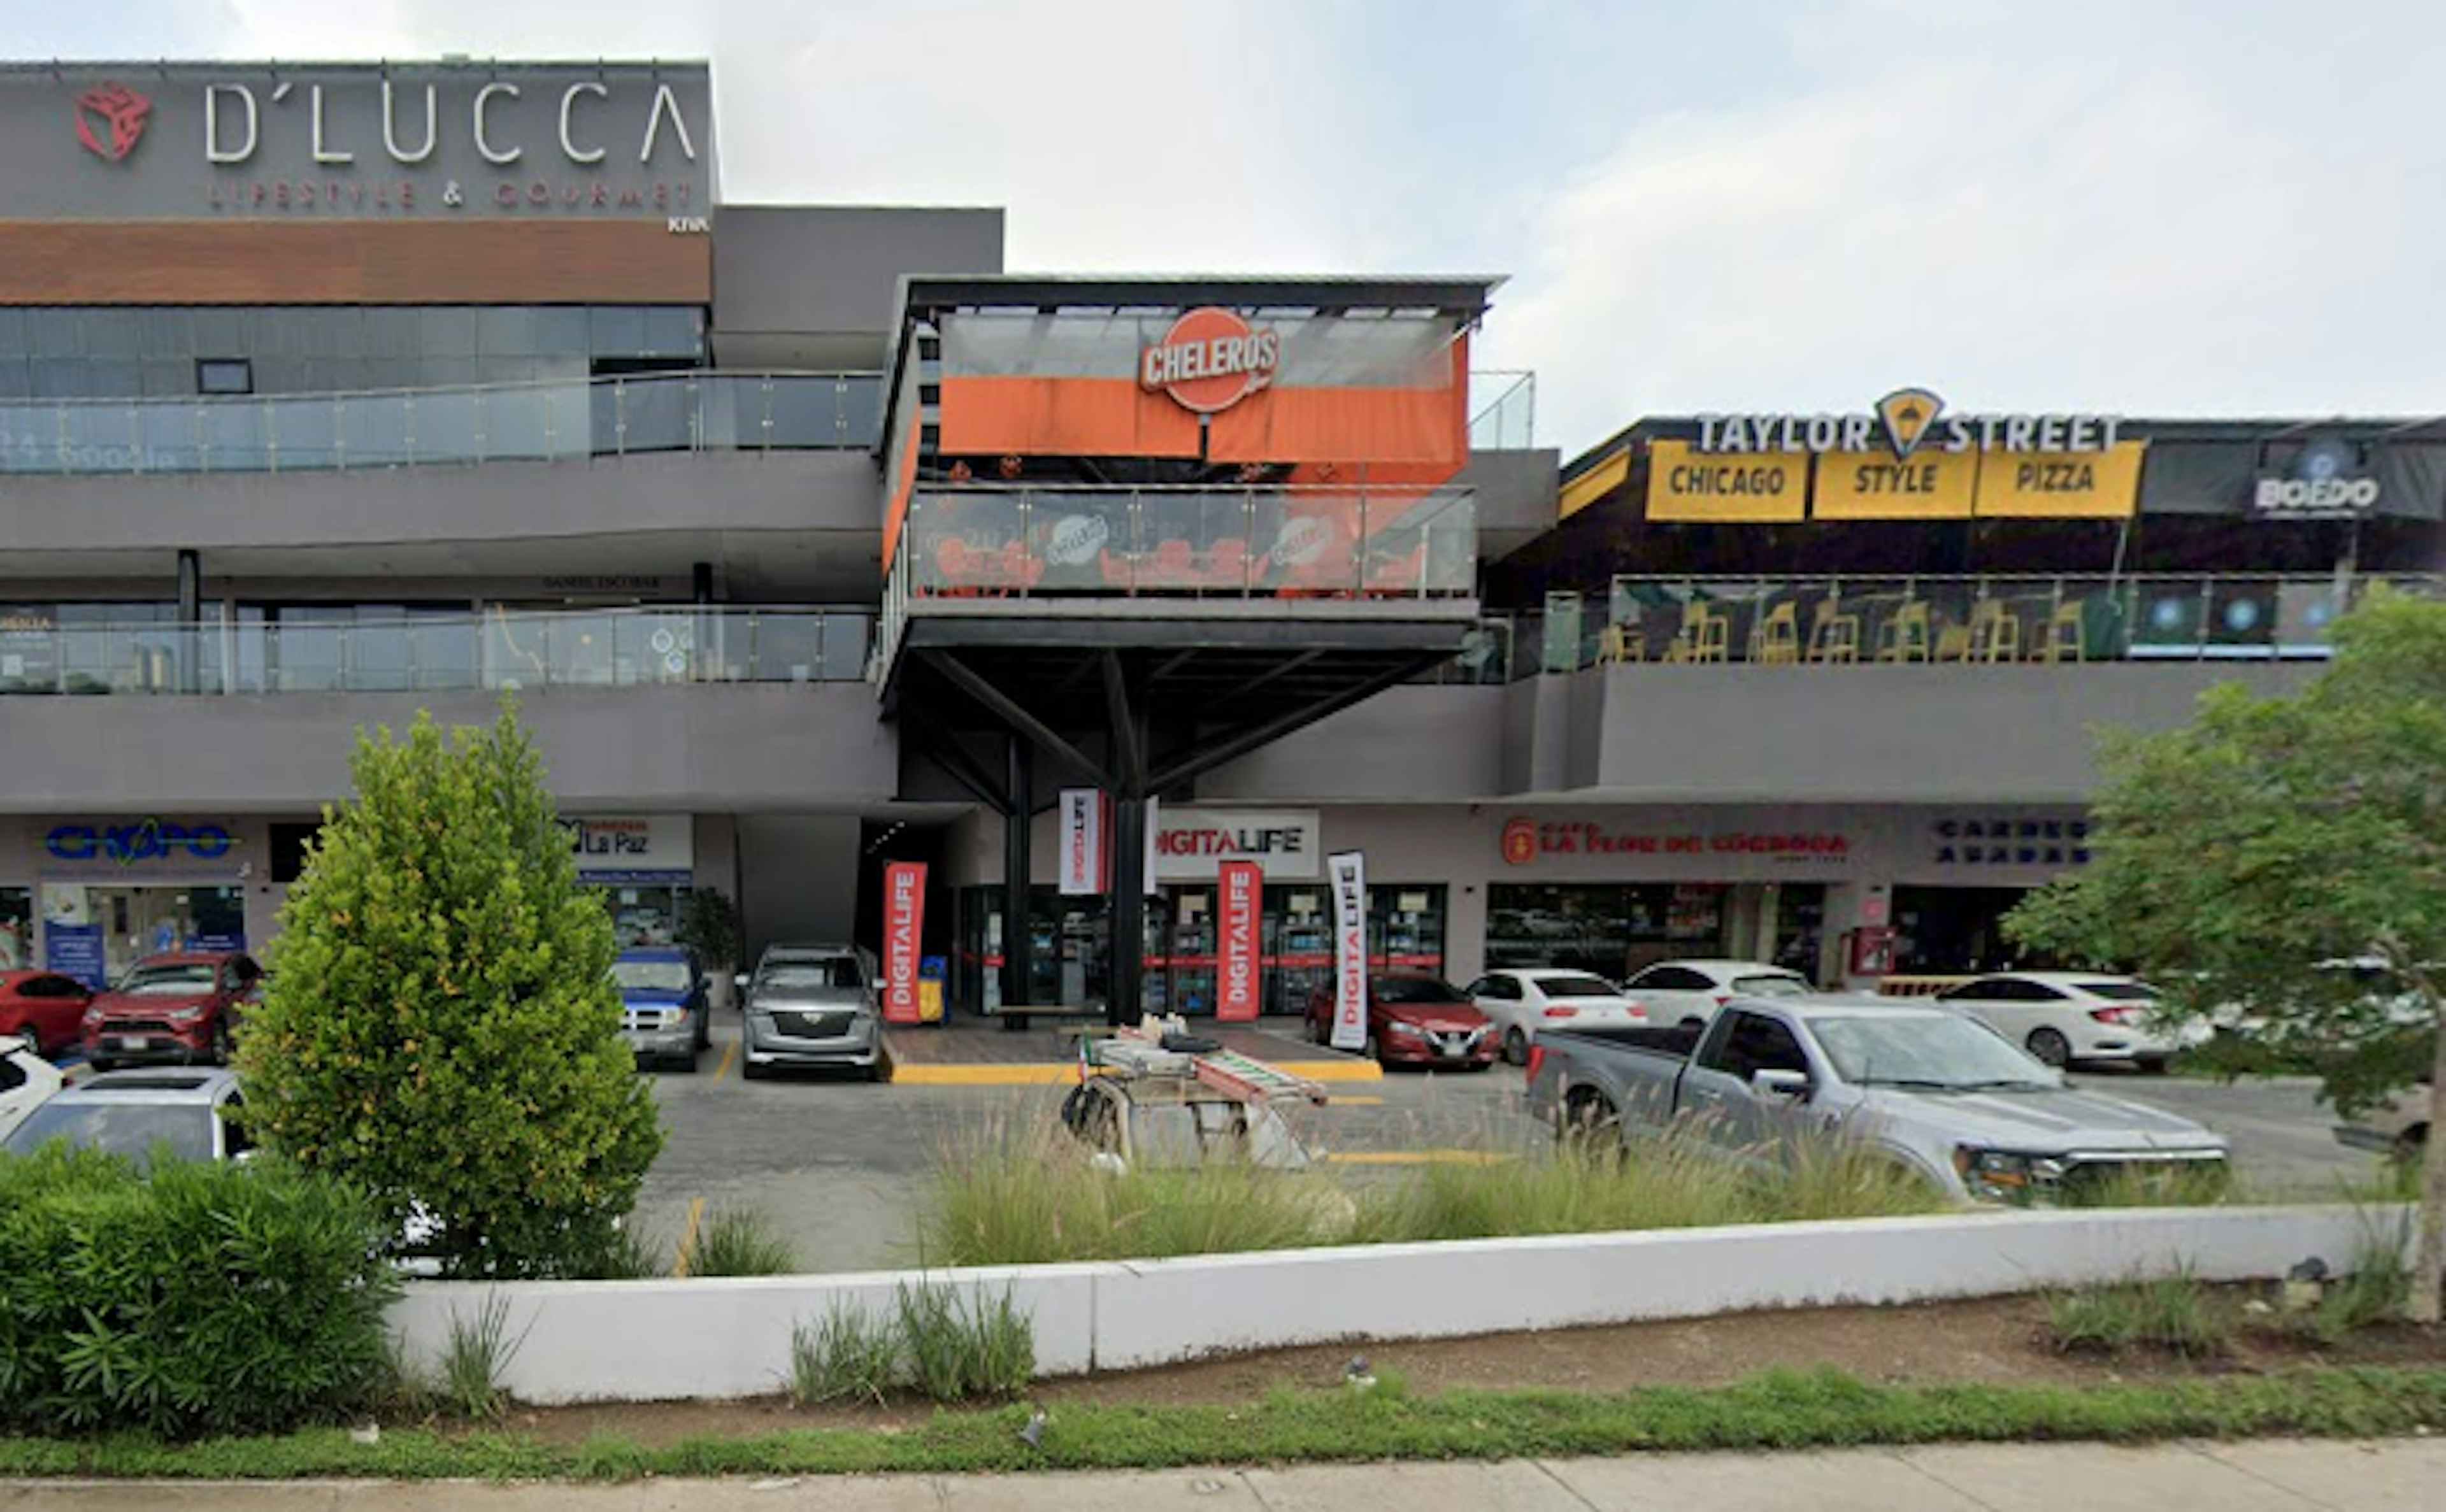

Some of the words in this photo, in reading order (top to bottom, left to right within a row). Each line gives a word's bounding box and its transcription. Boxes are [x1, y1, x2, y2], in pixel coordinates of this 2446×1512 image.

[207, 179, 414, 209] LIFESTYLE
[443, 180, 464, 207] &
[496, 181, 690, 208] GOURMET
[1147, 332, 1277, 383] CHELEROS
[1694, 413, 1871, 453] TAYLOR
[1943, 413, 2123, 453] STREET
[1669, 464, 1784, 496] CHICAGO
[1854, 464, 1937, 494] STYLE
[2016, 461, 2095, 492] PIZZA
[585, 832, 608, 853] La
[616, 832, 650, 854] Paz
[1156, 829, 1304, 854] IGITALIFE
[892, 871, 915, 1005] DIGITALIFE
[1229, 871, 1250, 1003] DIGITALIFE
[1340, 865, 1361, 1025] DIGITALIFE
